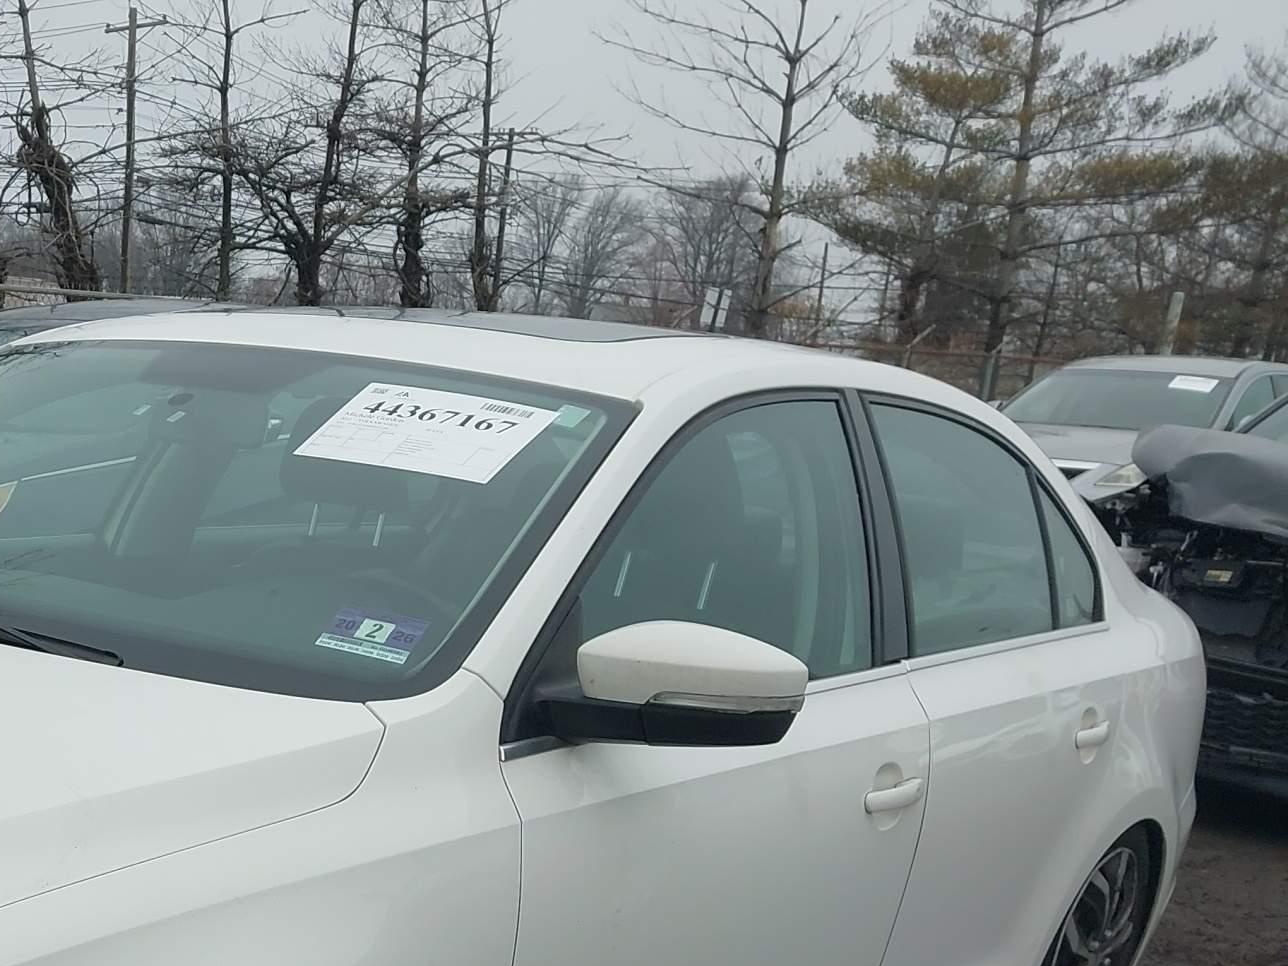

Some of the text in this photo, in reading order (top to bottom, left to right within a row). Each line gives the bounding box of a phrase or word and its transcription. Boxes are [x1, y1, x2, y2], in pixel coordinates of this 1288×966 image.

[362, 400, 520, 434] 44367167
[335, 618, 357, 631] 20
[364, 622, 385, 640] 2
